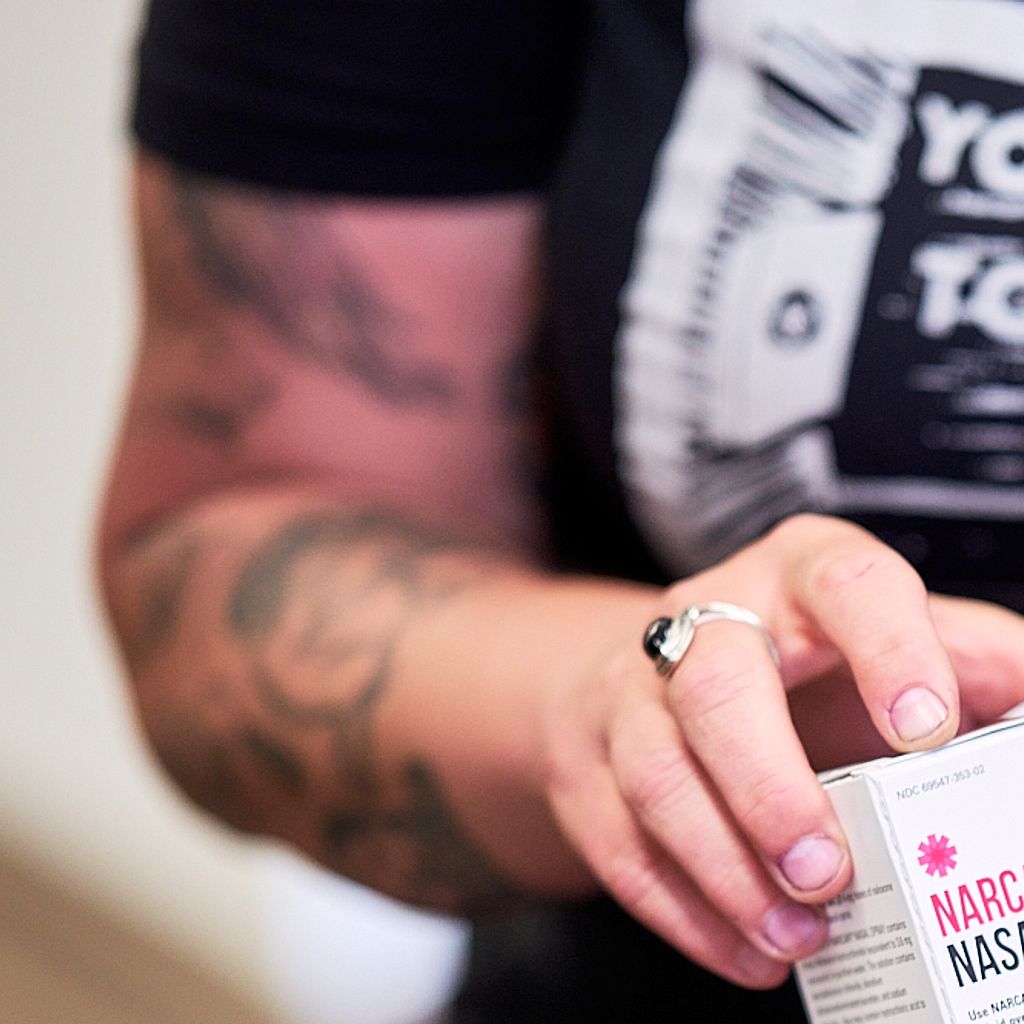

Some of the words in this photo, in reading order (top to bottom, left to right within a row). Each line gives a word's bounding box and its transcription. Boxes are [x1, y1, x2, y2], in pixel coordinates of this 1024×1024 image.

[896, 783, 920, 800] NDC
[921, 763, 985, 793] 69547-353-02
[967, 1008, 990, 1023] Use
